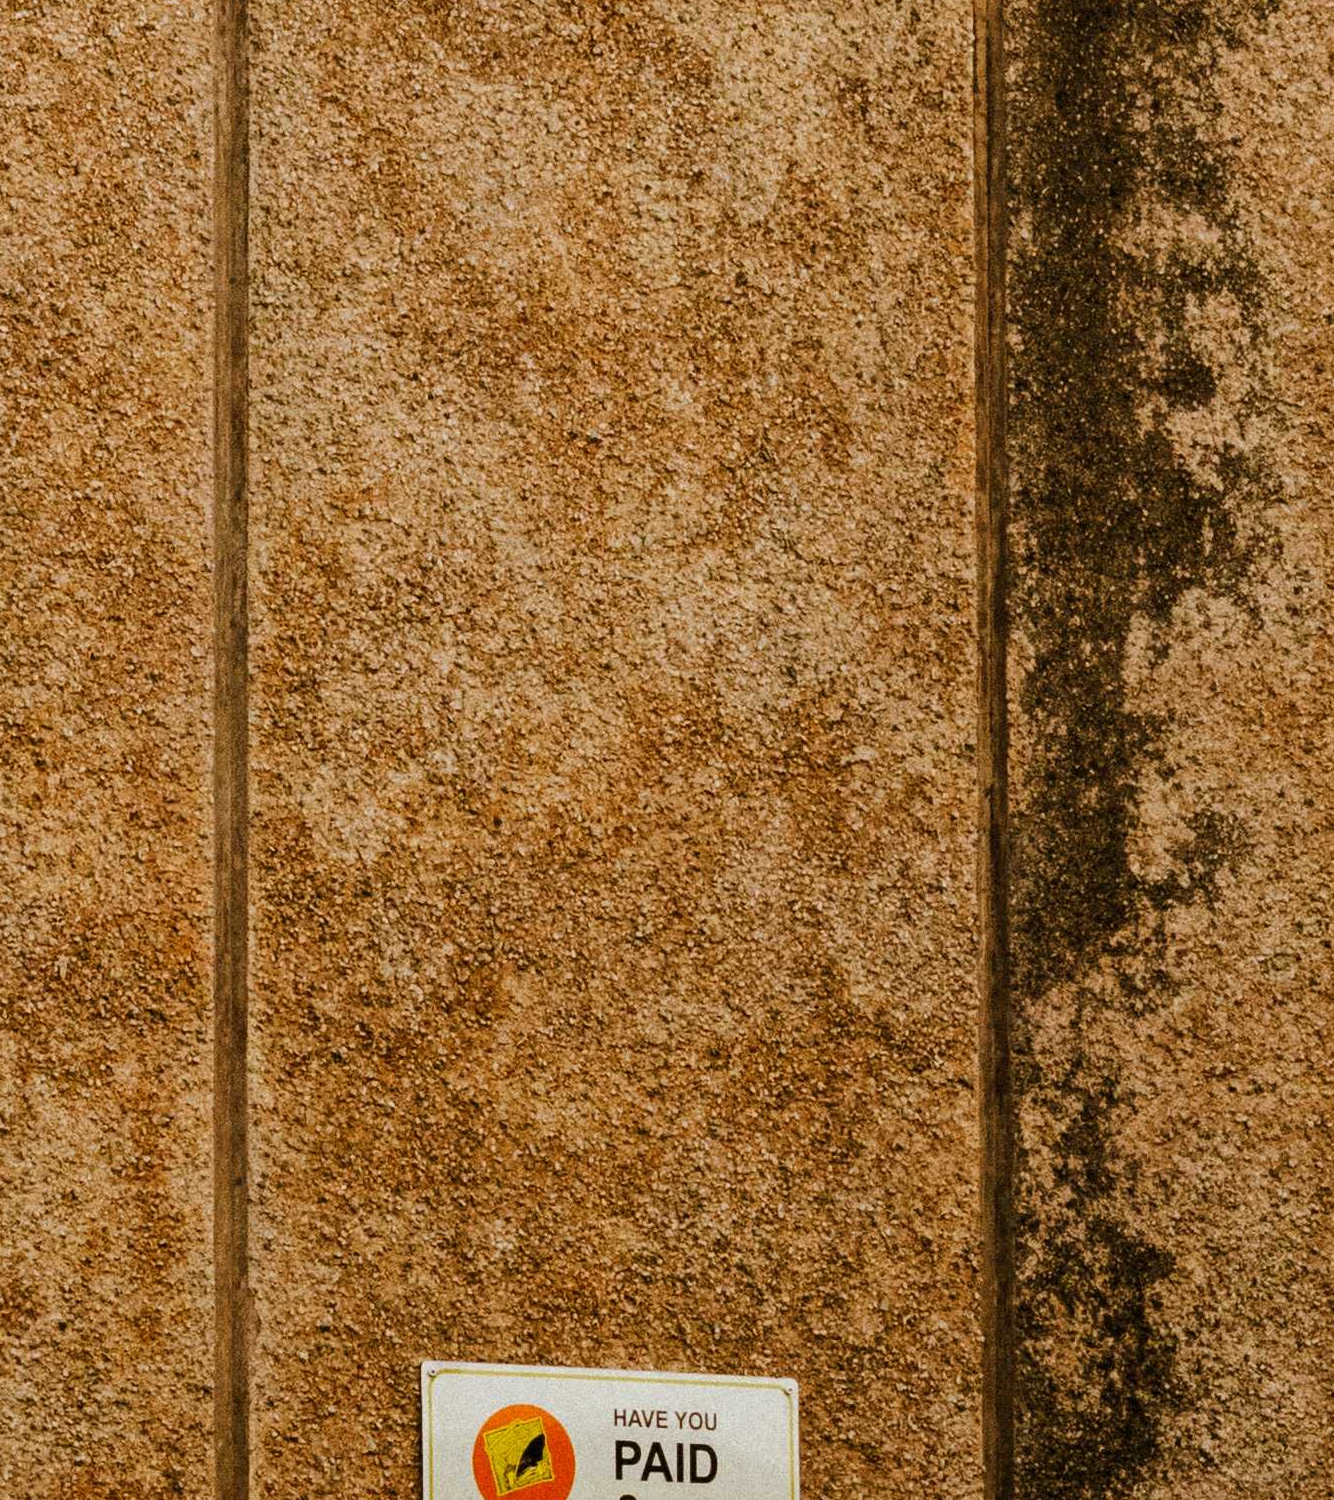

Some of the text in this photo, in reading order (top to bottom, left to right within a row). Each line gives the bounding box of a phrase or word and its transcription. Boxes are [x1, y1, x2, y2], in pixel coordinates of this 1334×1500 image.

[613, 1408, 718, 1431] HAVE YOU
[615, 1439, 718, 1484] PAID
